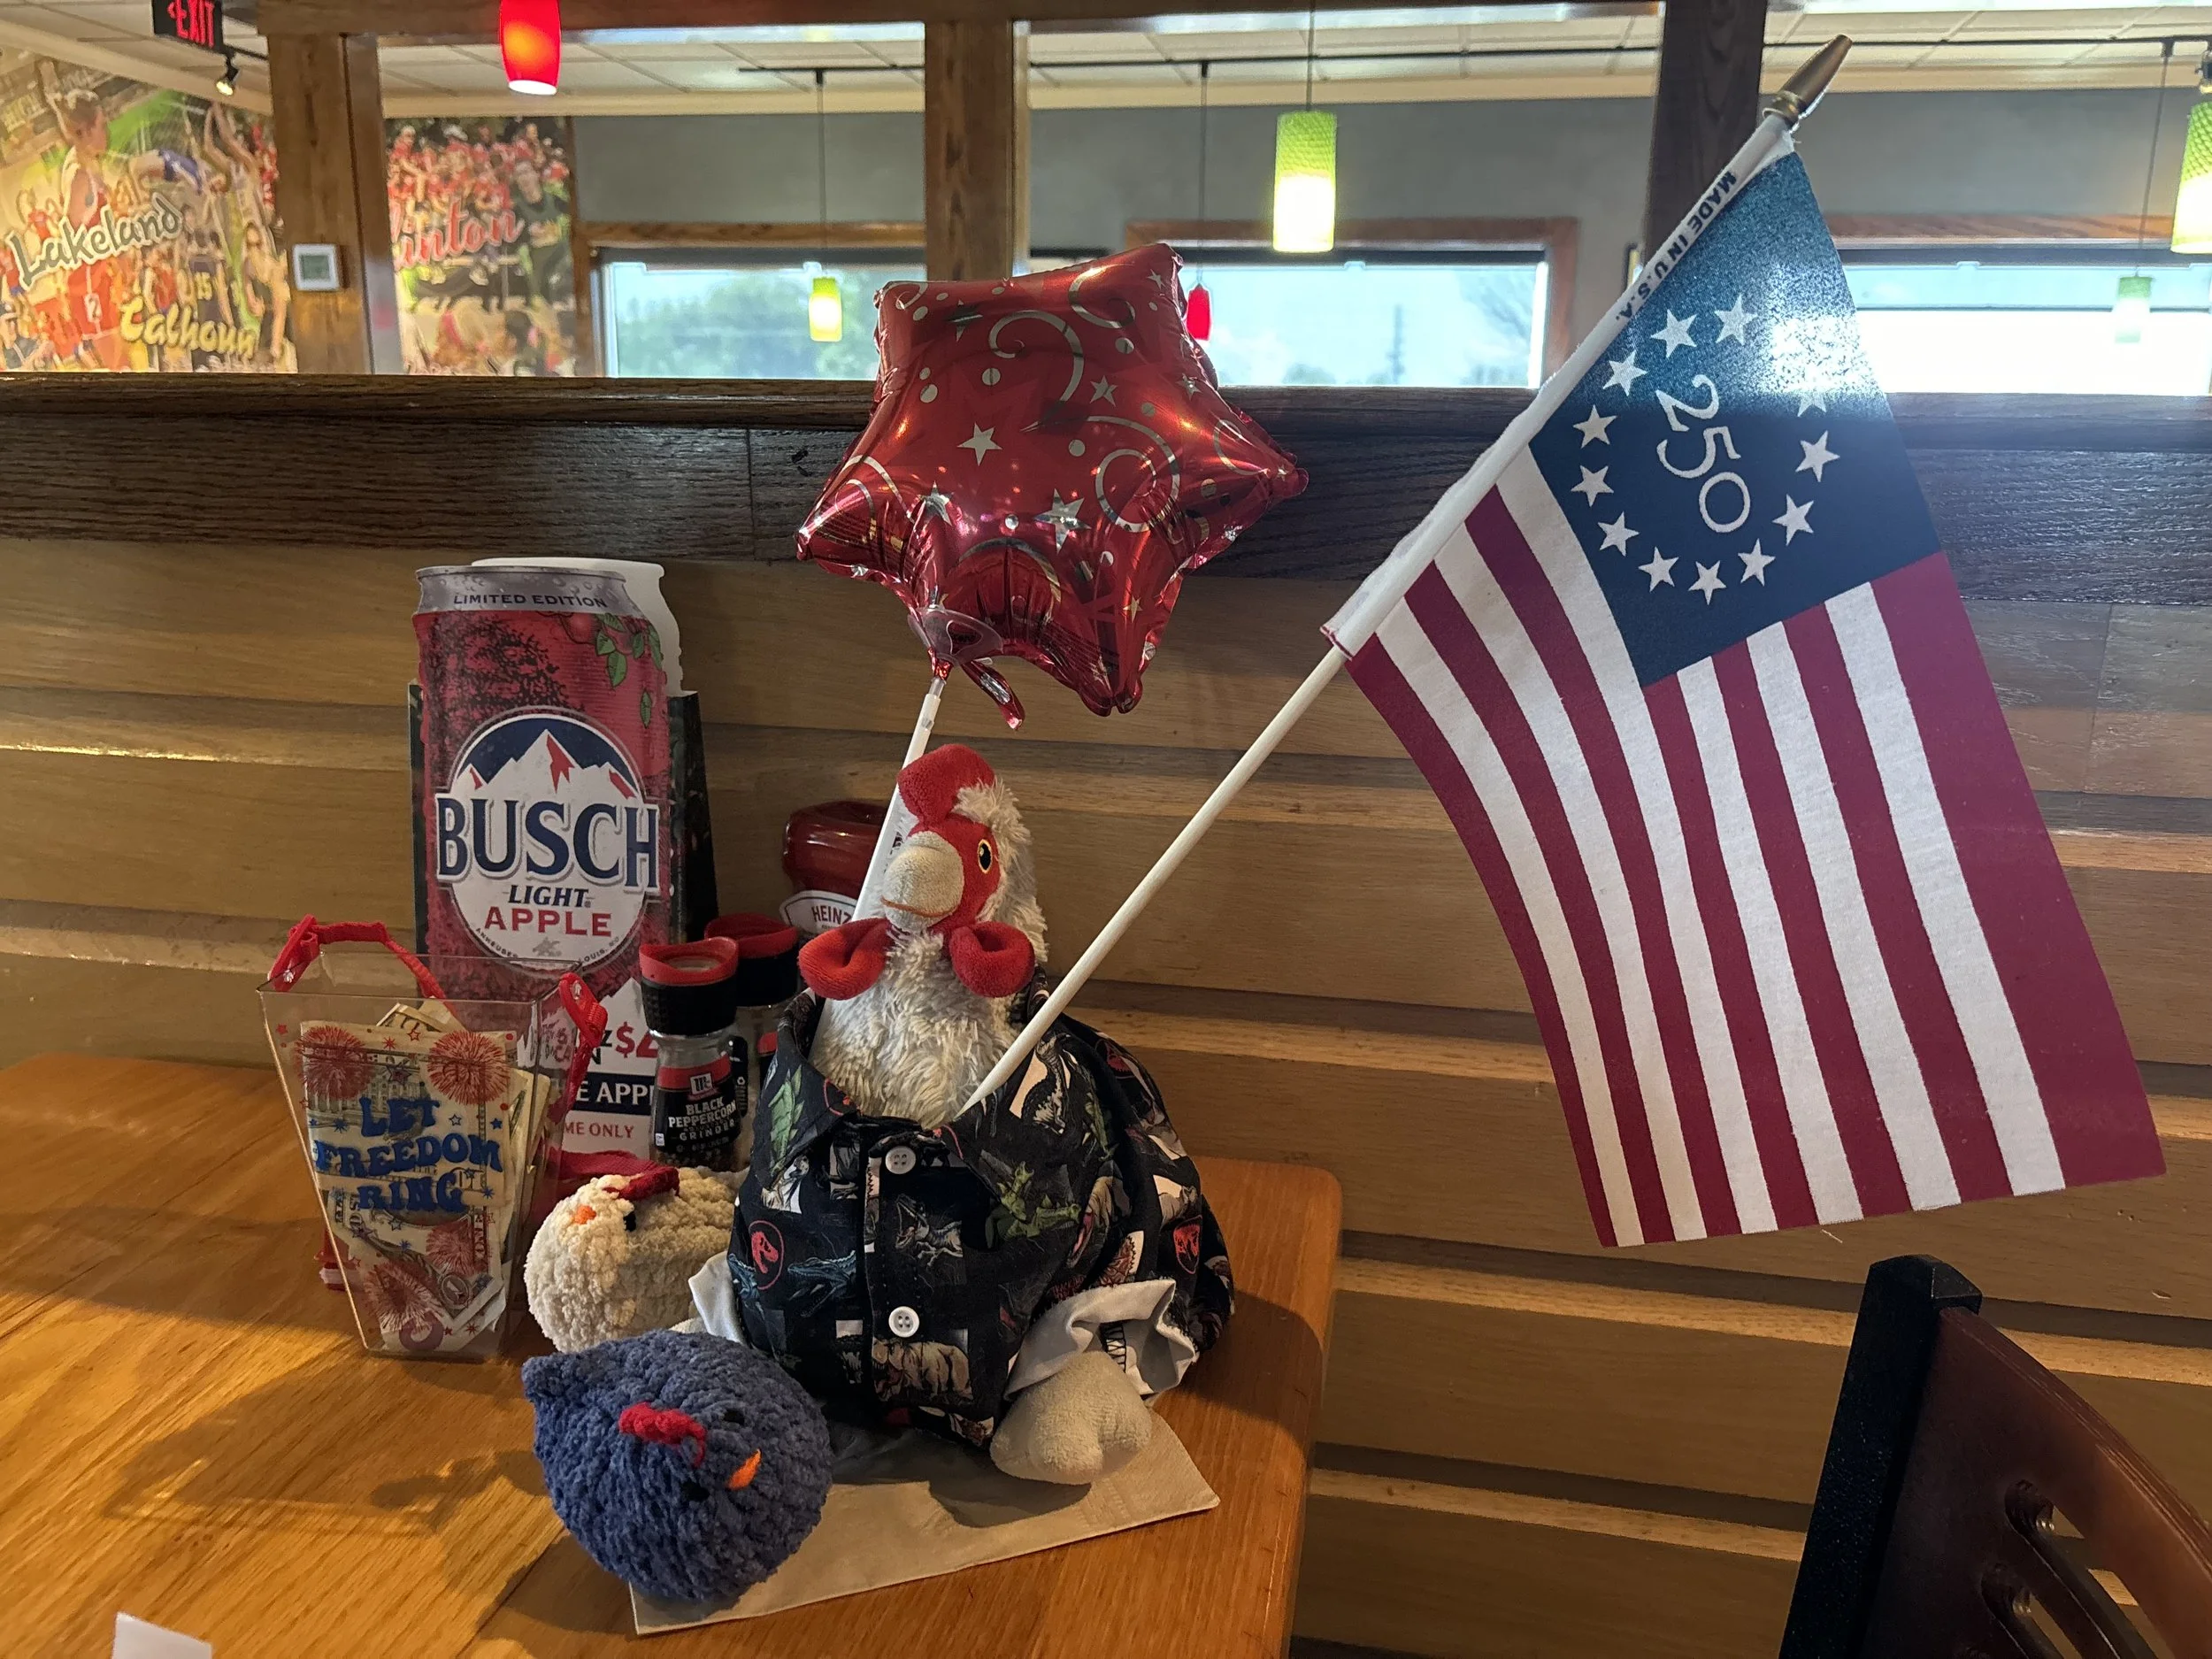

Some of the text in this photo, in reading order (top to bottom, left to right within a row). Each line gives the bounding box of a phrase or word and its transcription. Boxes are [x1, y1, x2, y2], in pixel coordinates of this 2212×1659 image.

[175, 0, 215, 49] EXIT
[5, 192, 182, 291] Lakeland
[1616, 170, 1738, 322] MADE IN U.S.A.
[120, 296, 261, 361] Calhoun
[1656, 373, 1752, 533] 250
[453, 594, 608, 609] LIMITED EDITION
[436, 796, 659, 888] BUSCH
[508, 885, 590, 908] LIGHT
[484, 906, 612, 937] APPLE
[595, 1081, 655, 1106] APP
[668, 1100, 737, 1128] PEPPERCORN
[685, 1096, 725, 1116] BLACK
[358, 1096, 441, 1138] LET
[588, 1122, 634, 1139] ONLY
[679, 1118, 735, 1141] GRINDER
[315, 1132, 503, 1179] FREEDOM
[357, 1171, 470, 1214] RING
